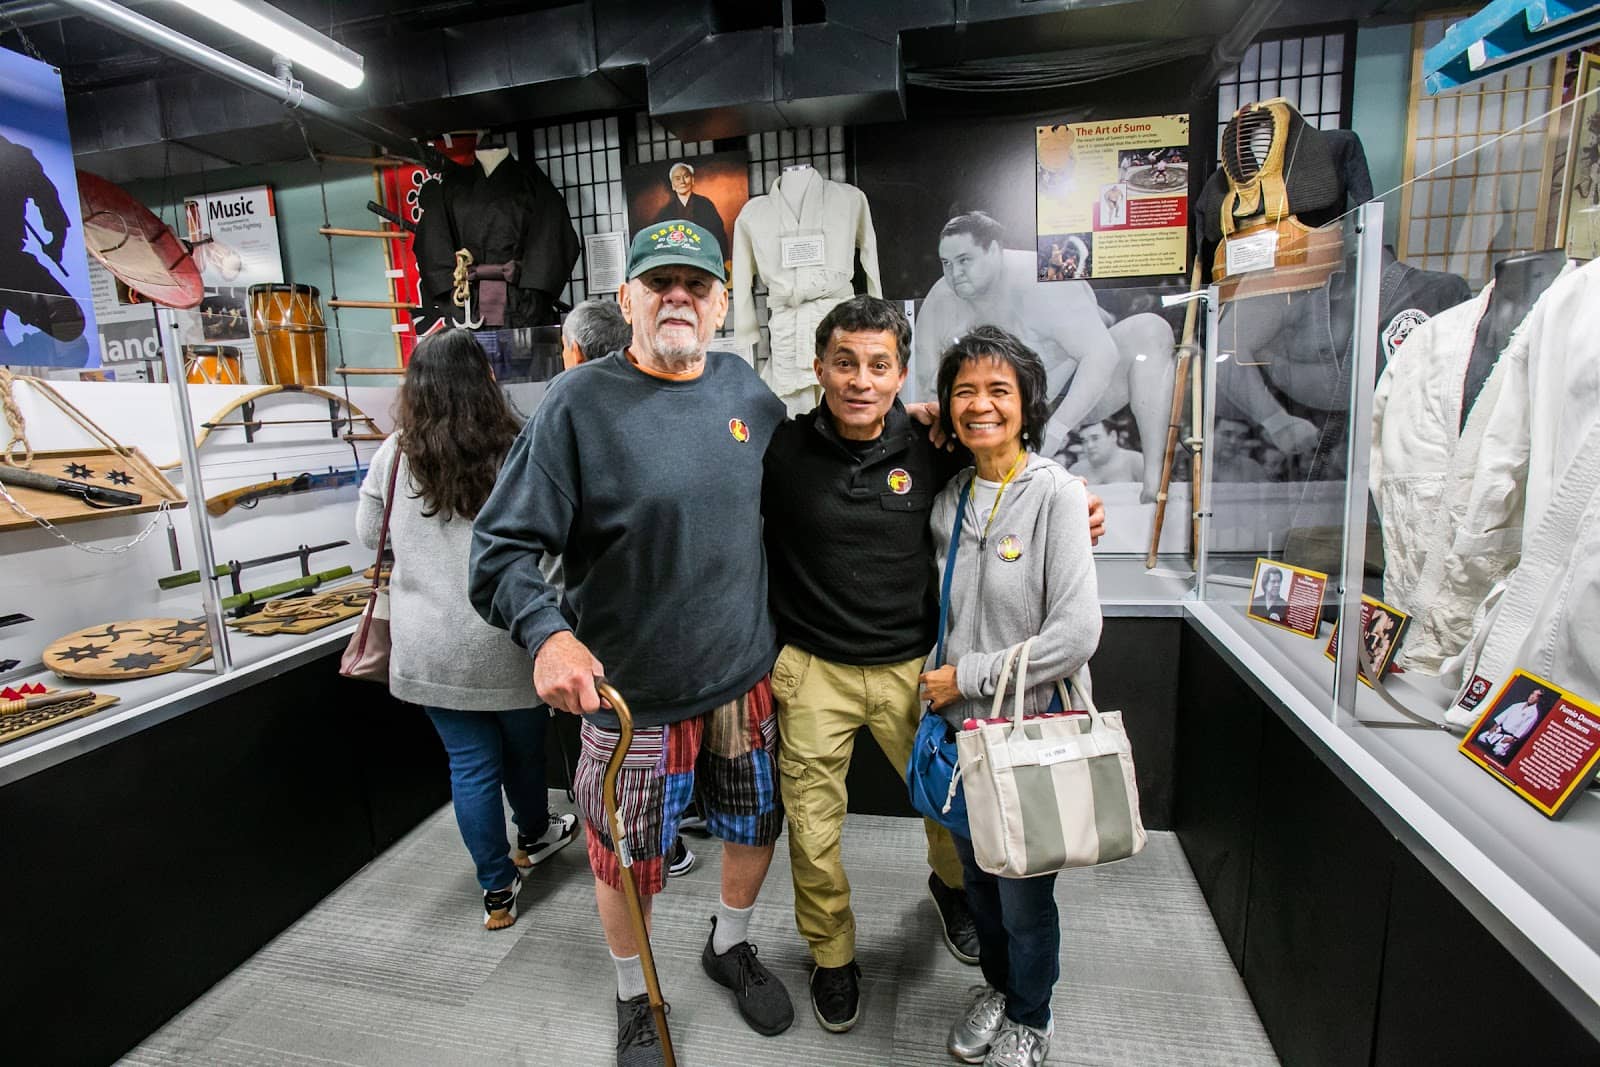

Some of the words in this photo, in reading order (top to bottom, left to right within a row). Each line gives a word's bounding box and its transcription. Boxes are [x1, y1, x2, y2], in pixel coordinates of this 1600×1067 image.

[1076, 127, 1094, 136] The
[1095, 126, 1110, 134] Art
[1112, 124, 1122, 133] of
[1124, 124, 1152, 132] Sumo
[209, 196, 254, 220] Music
[651, 224, 700, 244] OREGON
[1564, 716, 1590, 735] Uniform
